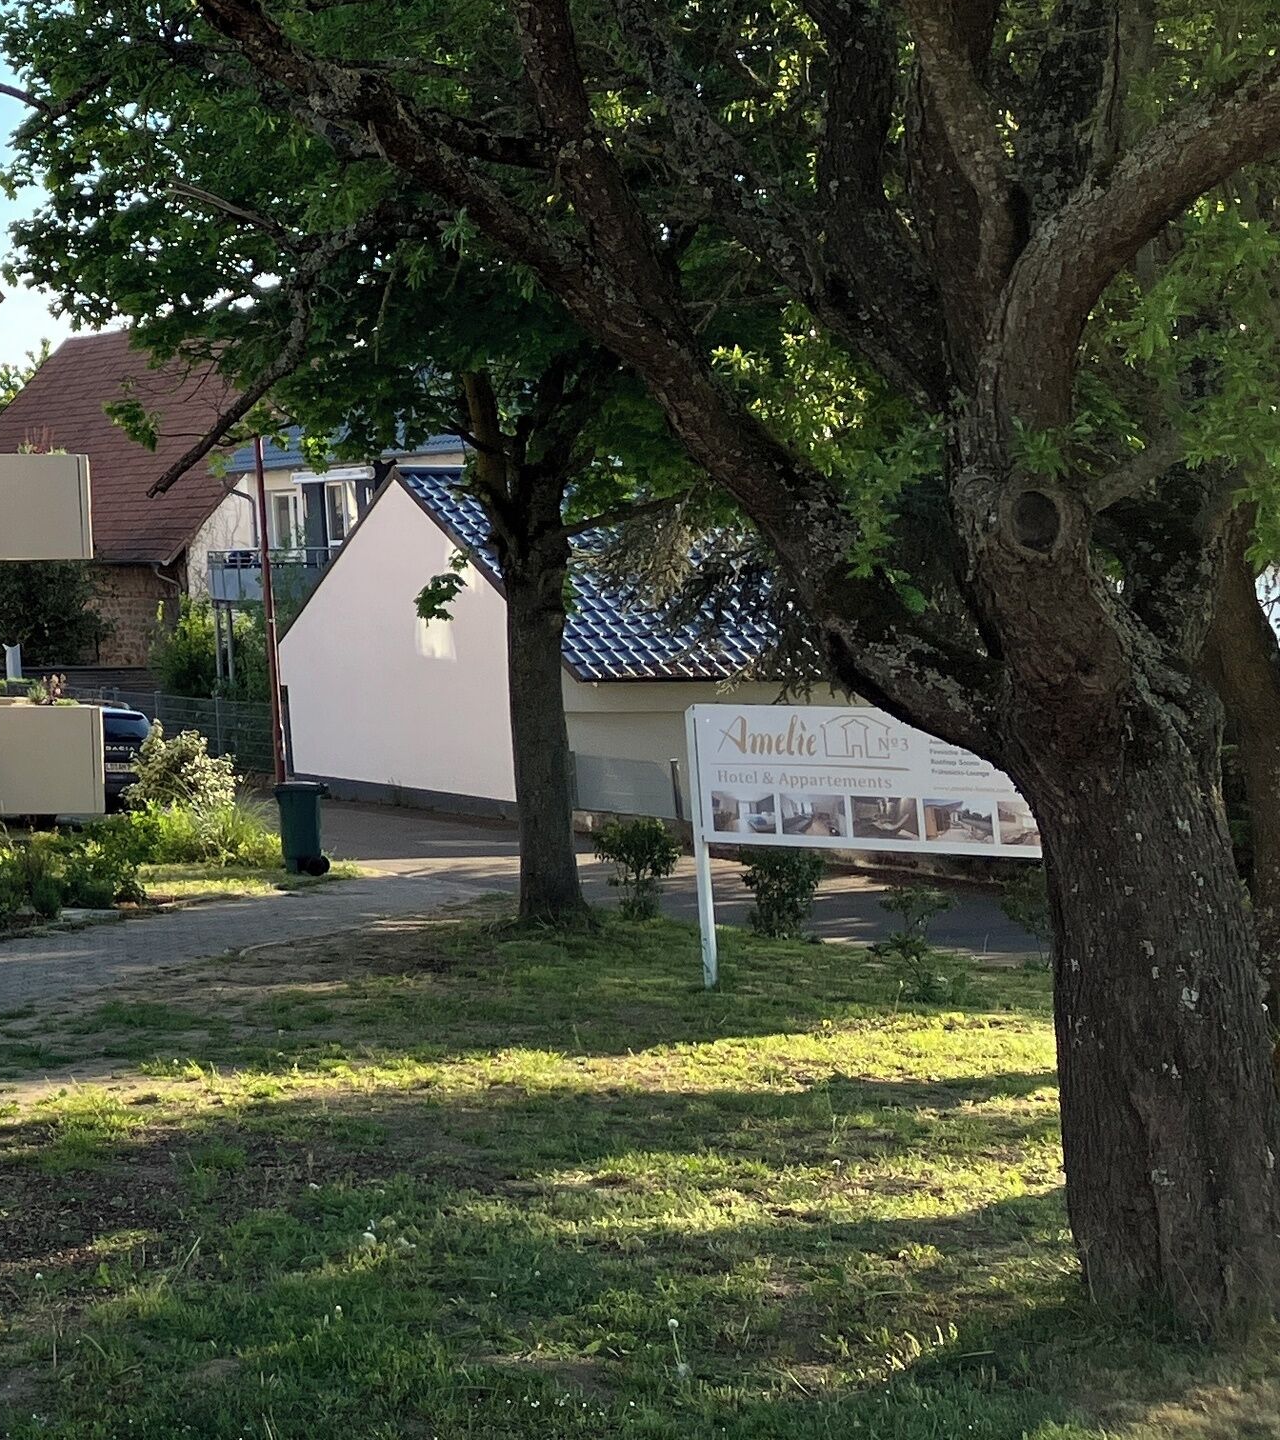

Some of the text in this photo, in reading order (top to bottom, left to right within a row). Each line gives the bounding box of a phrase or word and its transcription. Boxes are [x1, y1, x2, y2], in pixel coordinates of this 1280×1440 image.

[718, 714, 817, 756] Amelie
[717, 770, 893, 790] Hotel & Appartements
